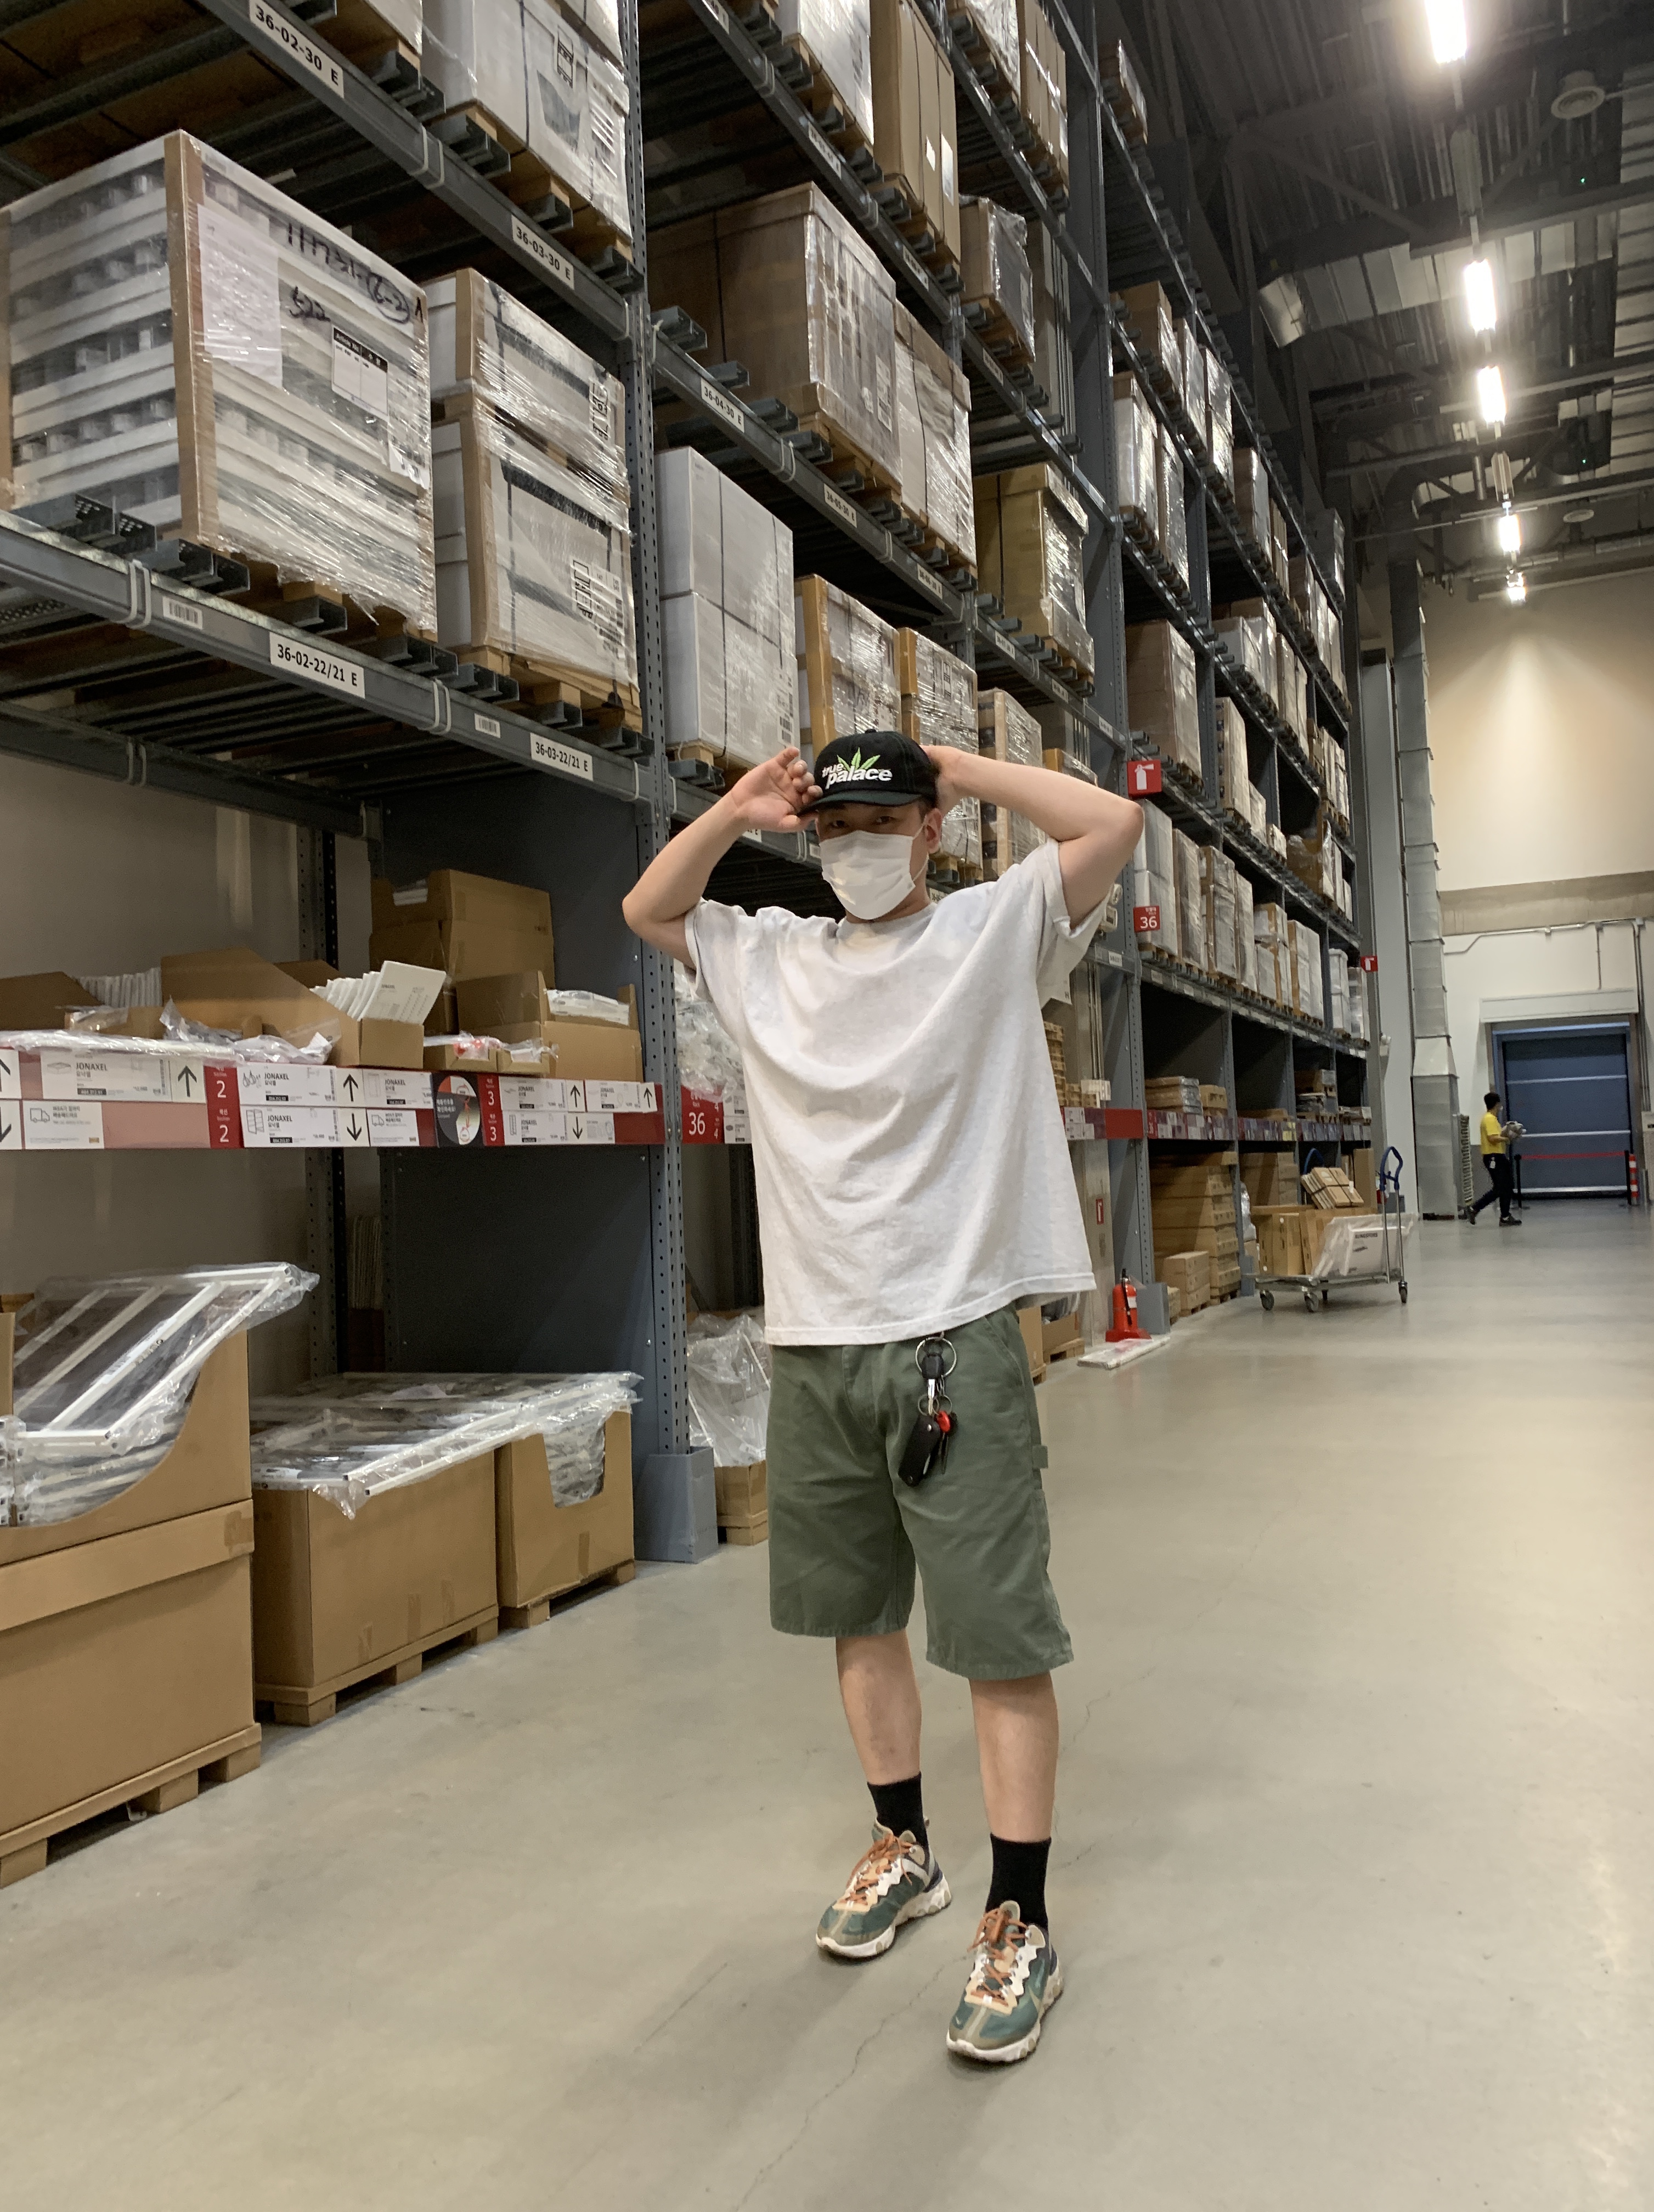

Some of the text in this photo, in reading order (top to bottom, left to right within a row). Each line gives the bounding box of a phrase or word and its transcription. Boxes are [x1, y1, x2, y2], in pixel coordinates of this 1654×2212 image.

[256, 4, 338, 86] 36-02-30 E
[517, 226, 571, 280] 36-03-30 E
[704, 386, 742, 425] 36-04-30 E
[827, 489, 855, 521] 36-05-30 E
[278, 644, 358, 687] 36-02-22/21 E
[535, 742, 588, 772] 36-03-22/21 E
[822, 763, 845, 778] true
[825, 765, 893, 790] palace
[1140, 916, 1158, 929] 36
[75, 1062, 109, 1071] JONAXEL
[216, 1080, 227, 1098] 2
[488, 1091, 494, 1106] 3
[219, 1124, 229, 1143] 2
[490, 1126, 497, 1142] 3
[688, 1111, 706, 1136] 36
[714, 1127, 719, 1139] 4
